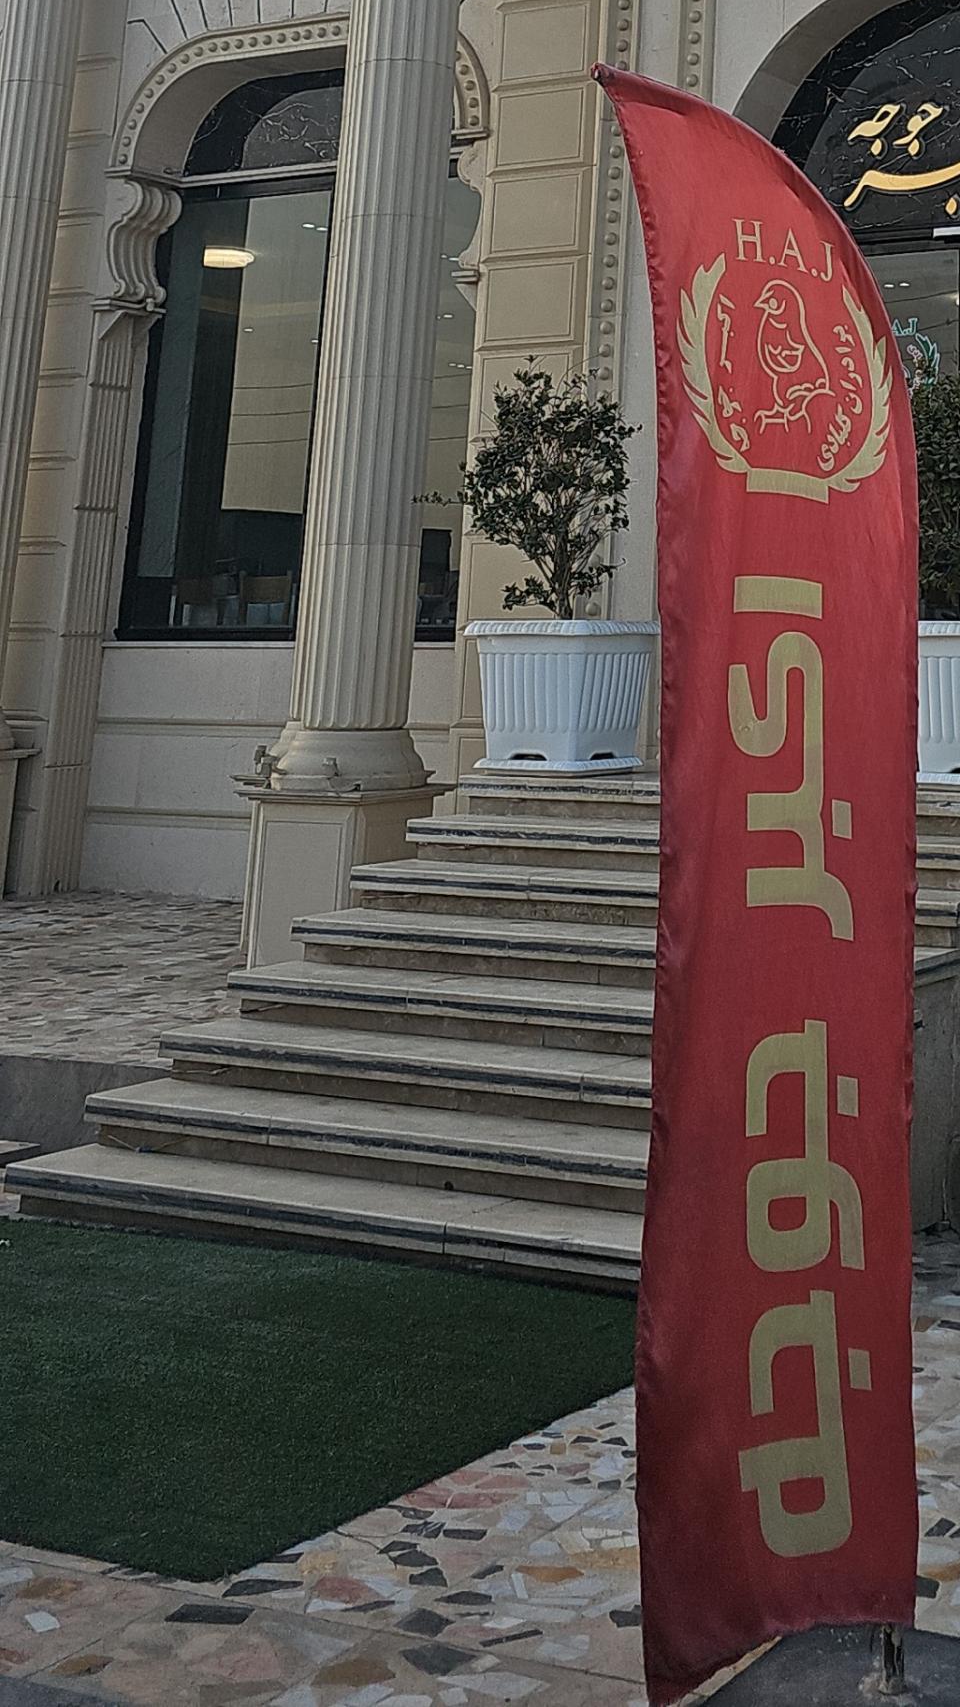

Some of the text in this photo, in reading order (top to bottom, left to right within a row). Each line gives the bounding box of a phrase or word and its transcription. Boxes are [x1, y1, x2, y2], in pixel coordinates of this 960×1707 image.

[848, 104, 944, 158] جوجه
[731, 218, 836, 283] H.A.J
[728, 575, 873, 1558] اکبر جوجه
